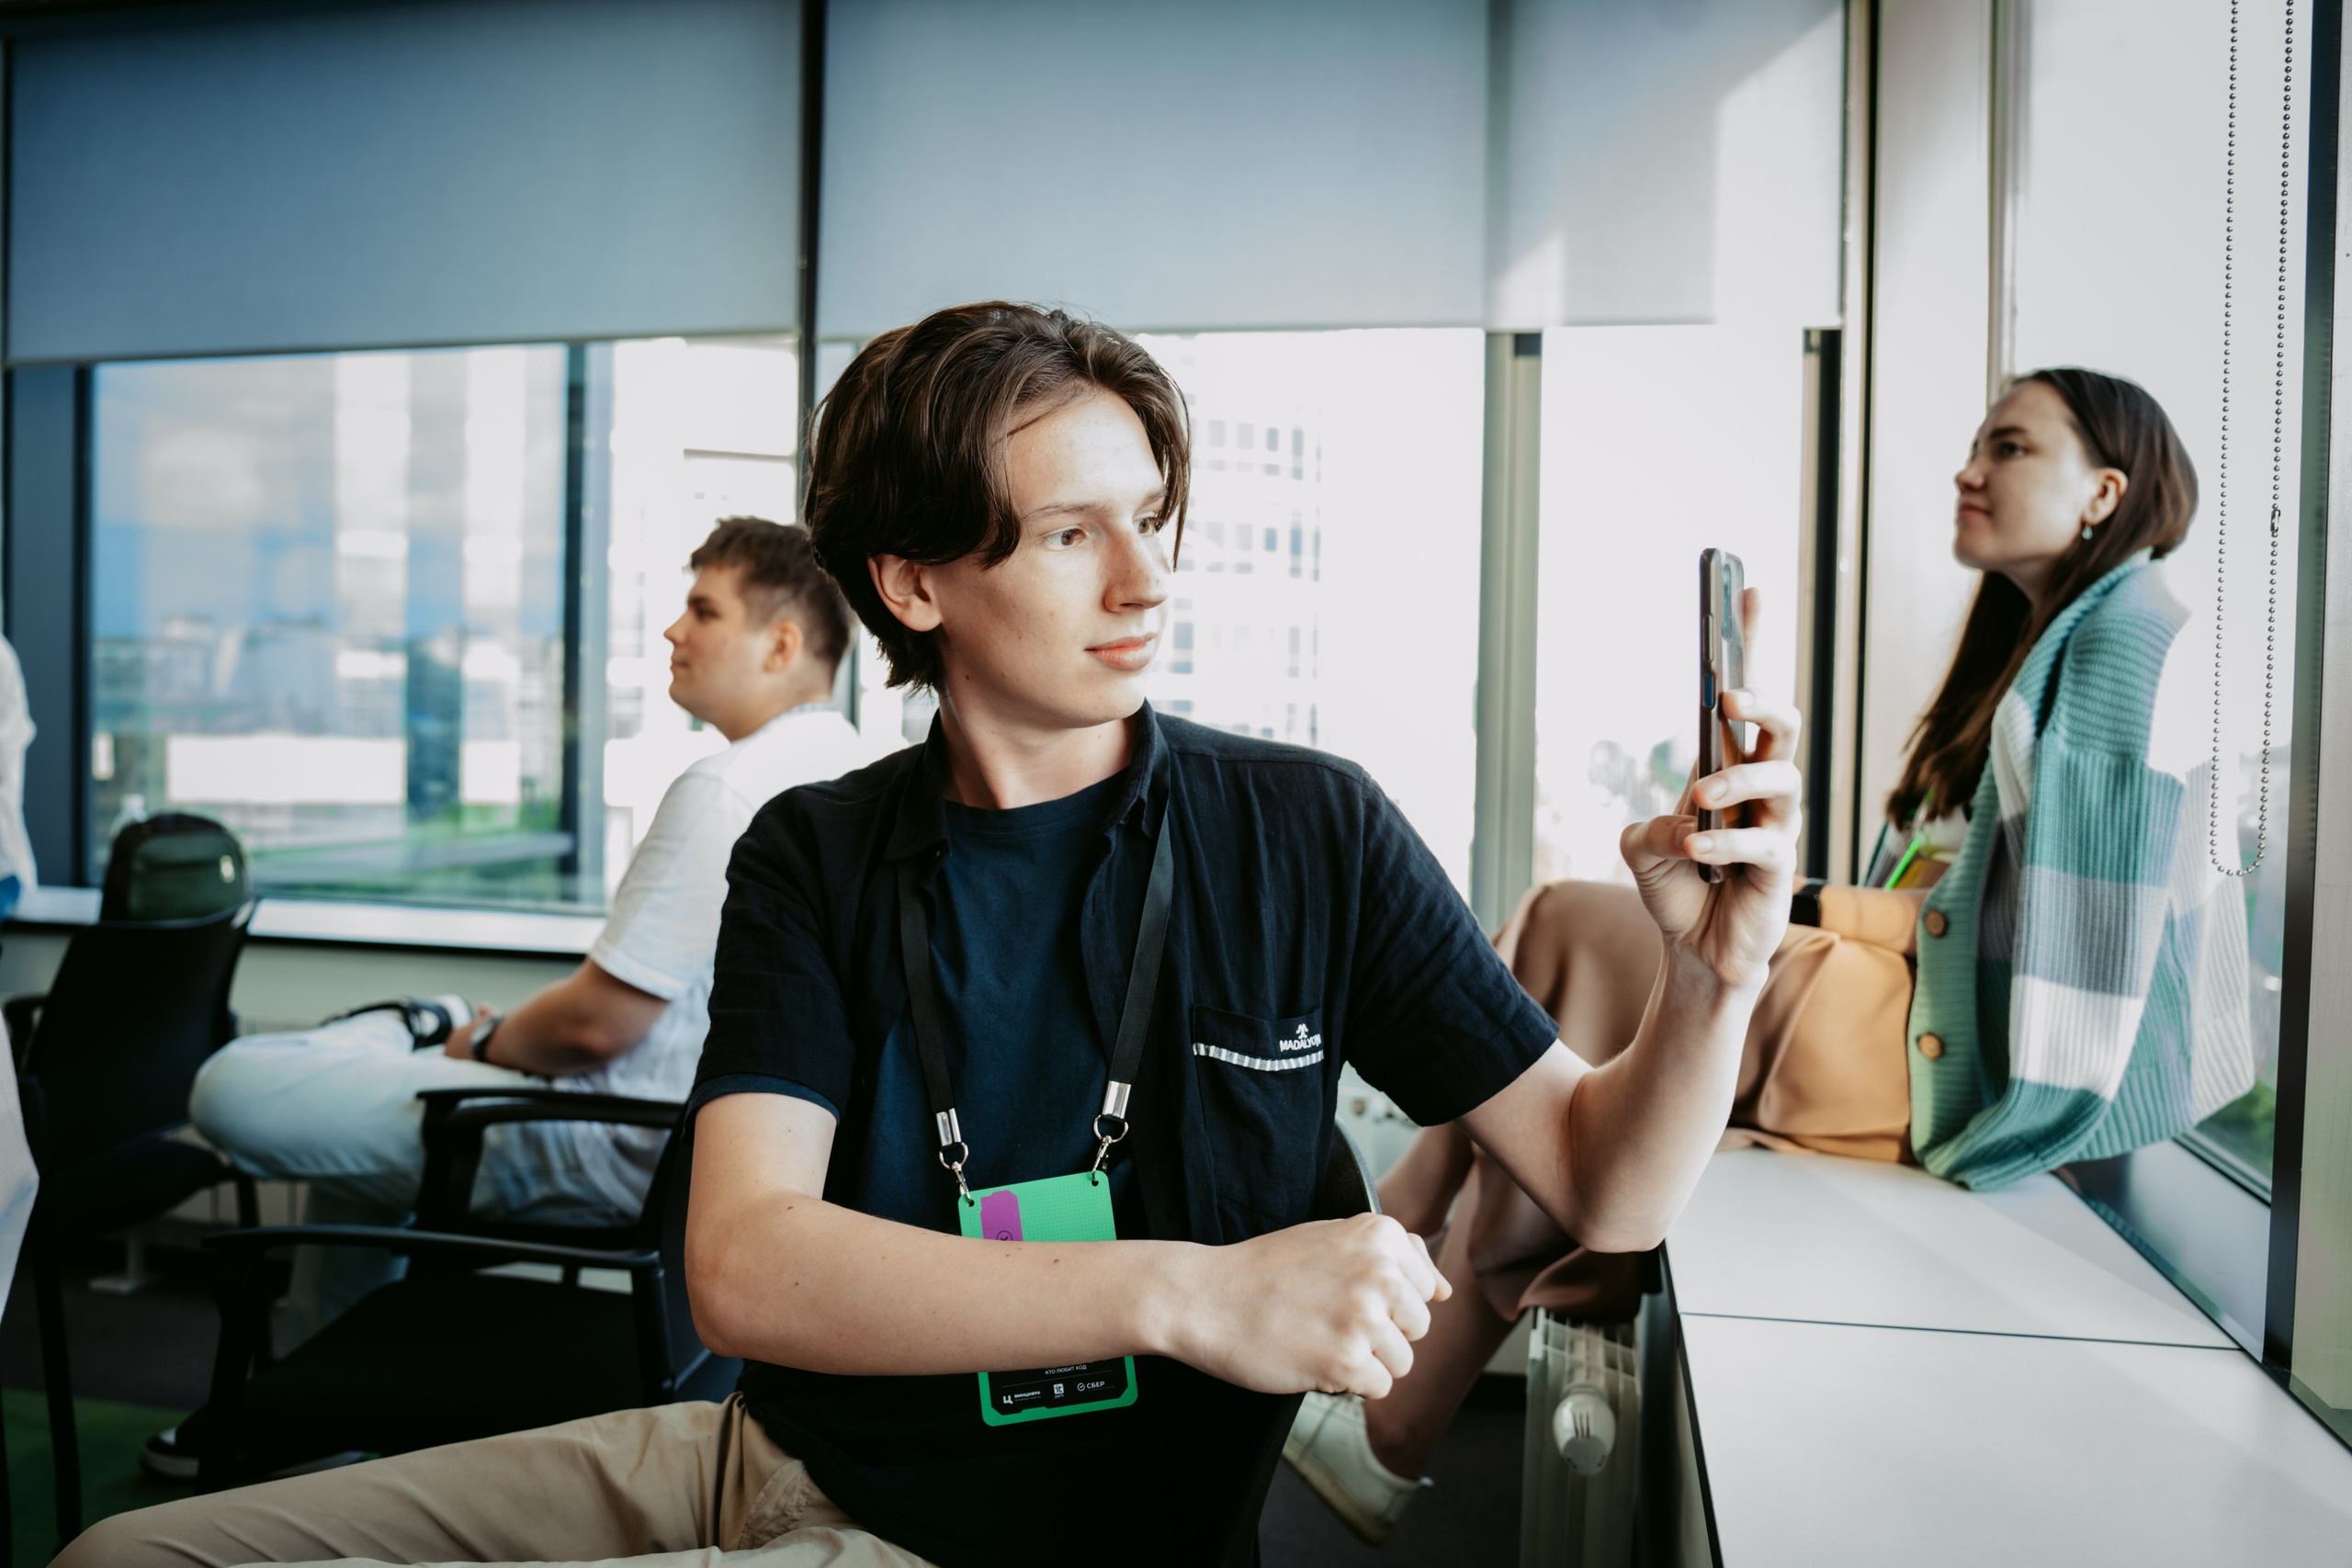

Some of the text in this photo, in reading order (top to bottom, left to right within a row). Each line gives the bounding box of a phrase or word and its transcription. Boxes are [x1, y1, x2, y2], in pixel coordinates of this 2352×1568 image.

[1279, 1033, 1321, 1052] MADALYON
[1057, 1366, 1075, 1374] ЛЮБИТ
[1086, 1381, 1105, 1389] СБЕР
